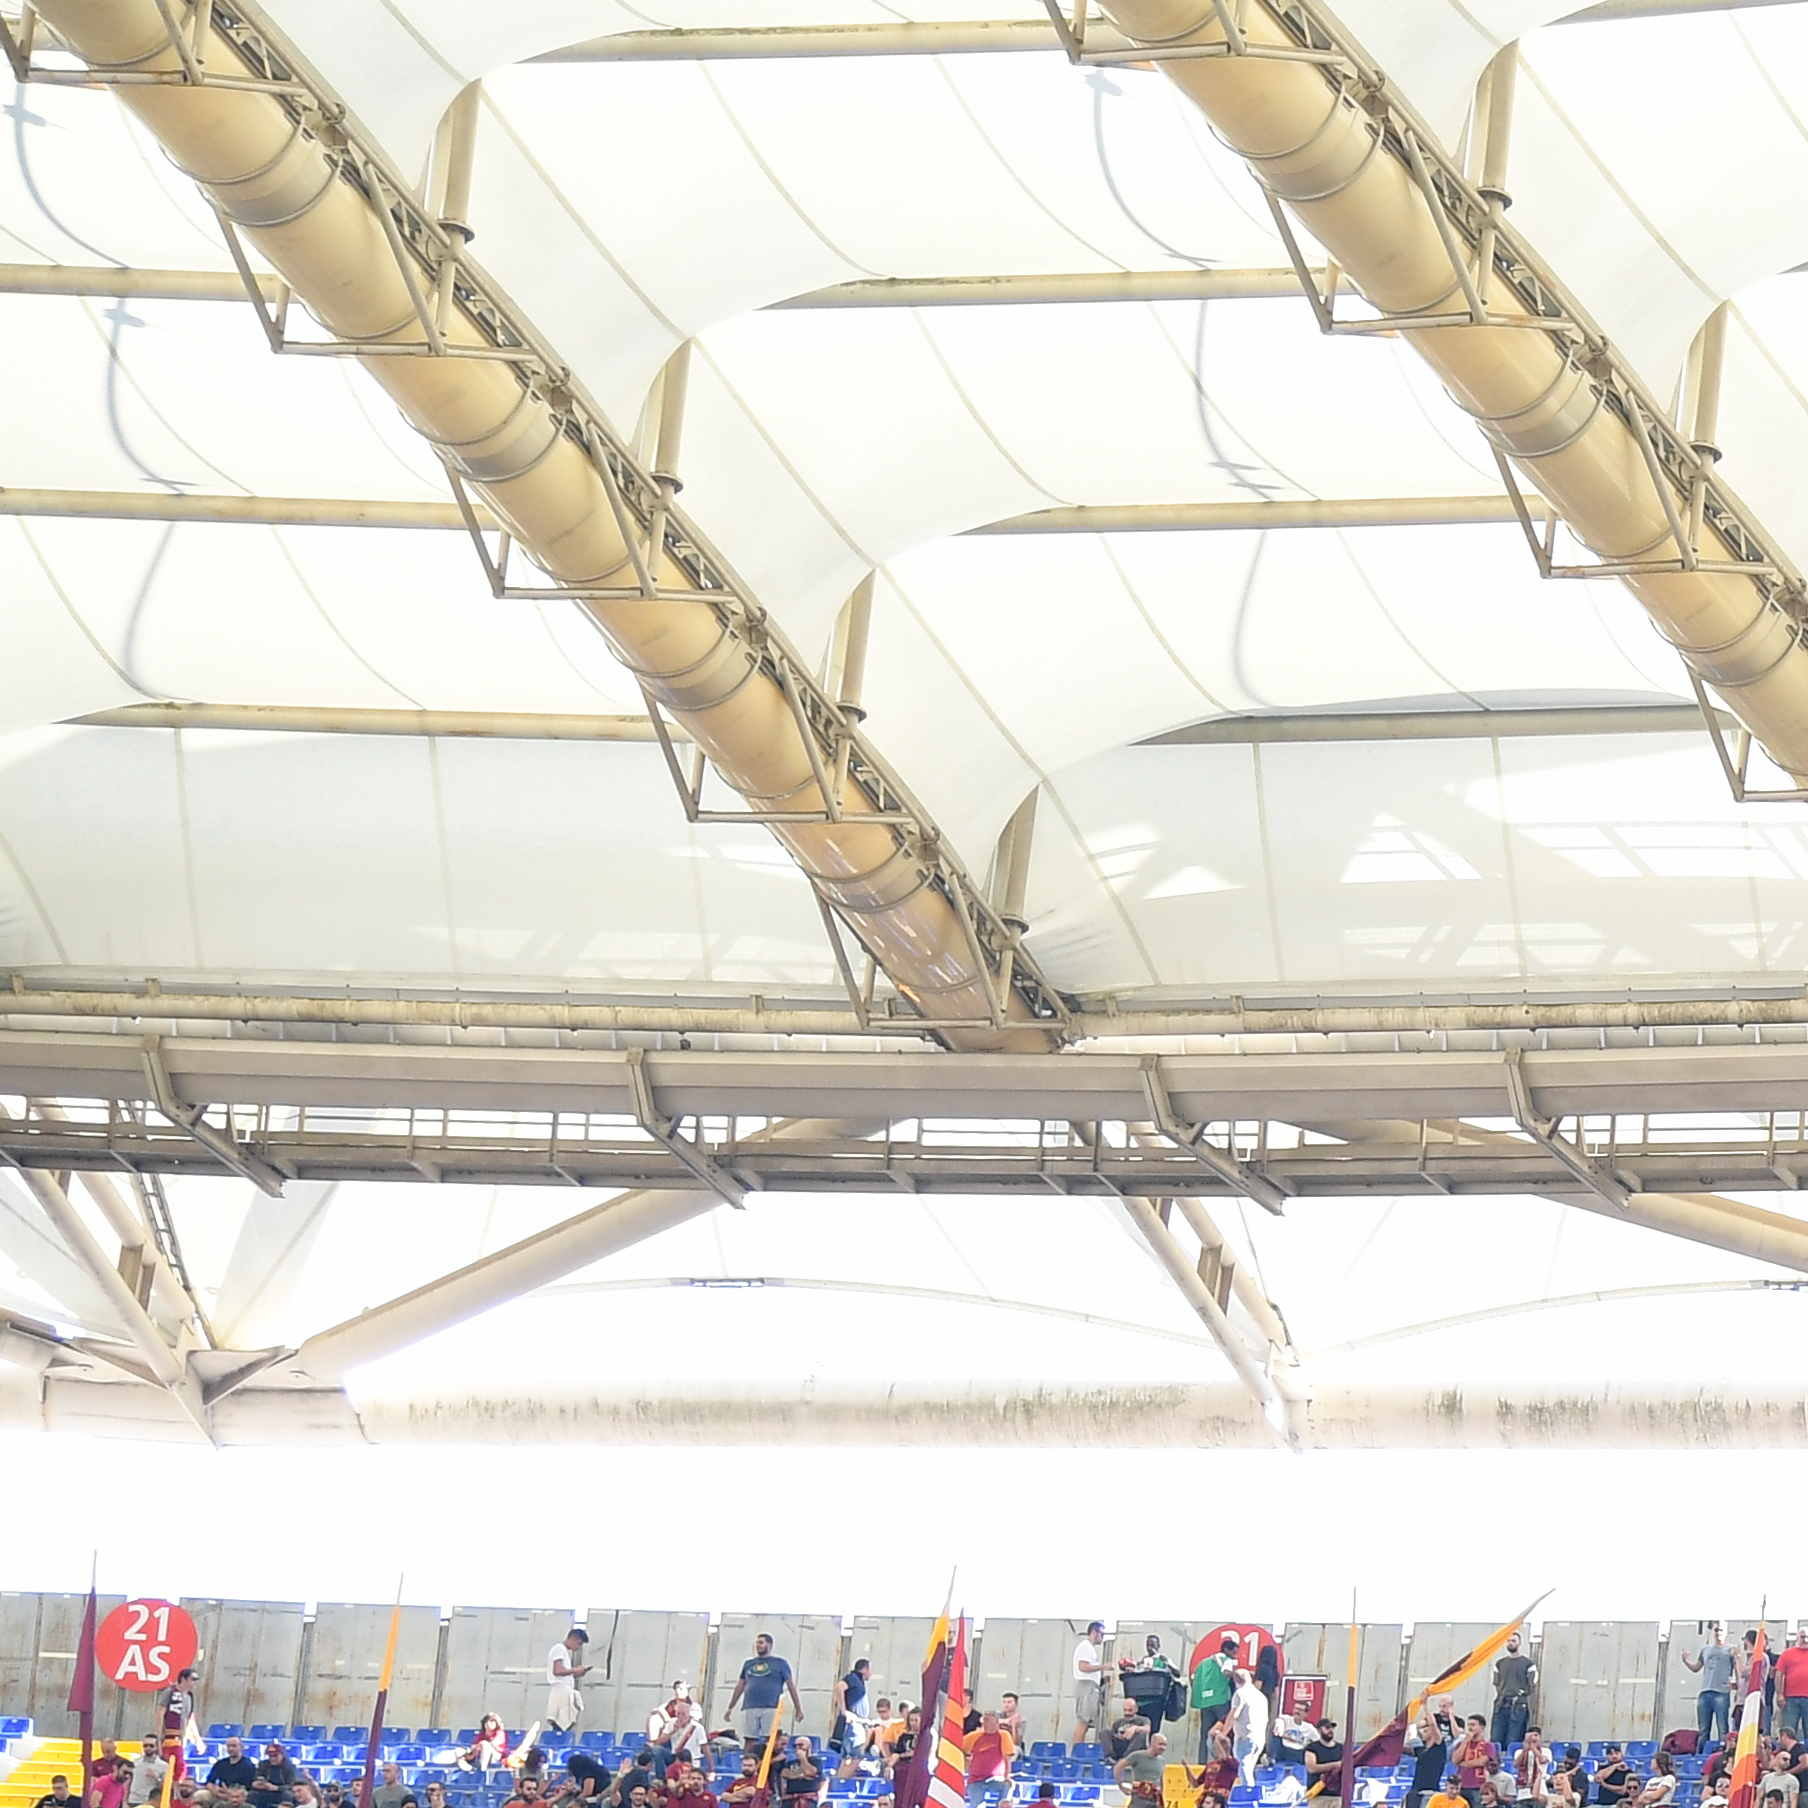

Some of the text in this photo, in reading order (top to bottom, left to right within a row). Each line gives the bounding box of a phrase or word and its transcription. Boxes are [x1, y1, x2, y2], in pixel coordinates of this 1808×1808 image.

[123, 1605, 170, 1641] 21
[114, 1645, 171, 1681] AS
[1166, 1801, 1179, 1808] 74
